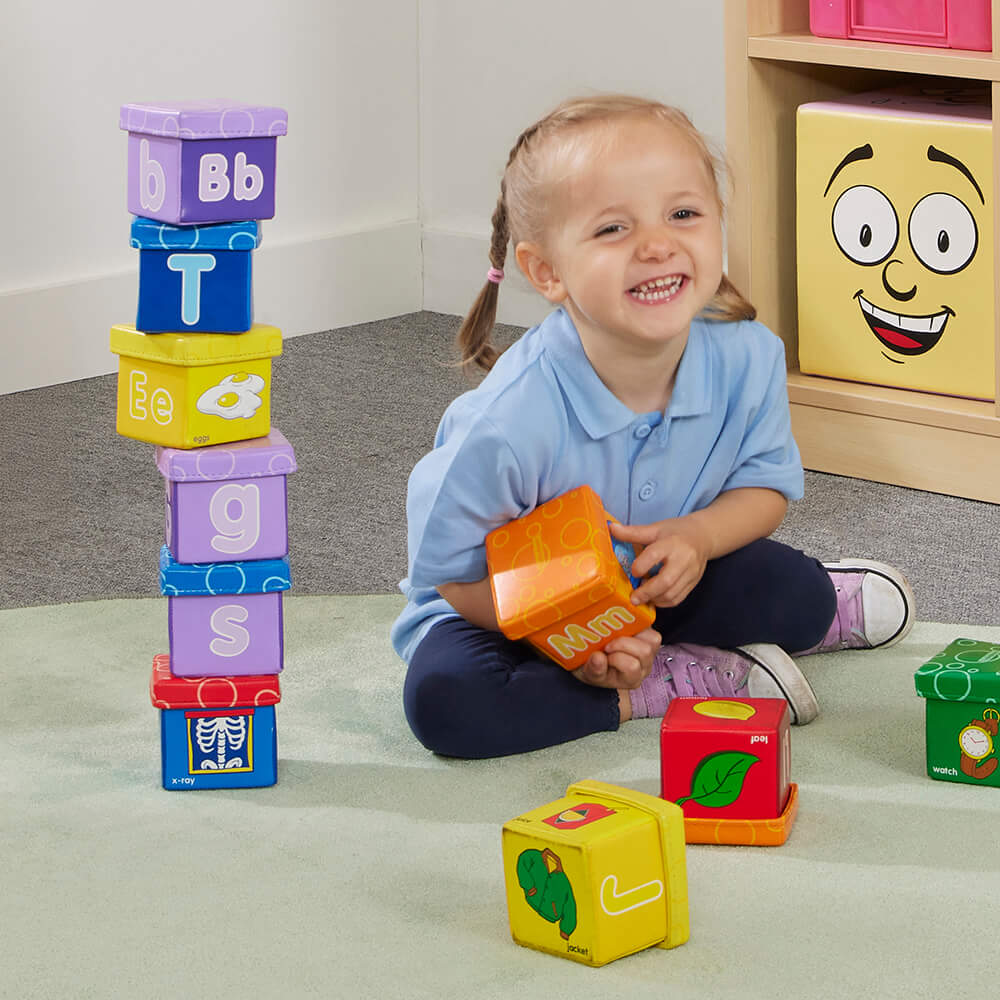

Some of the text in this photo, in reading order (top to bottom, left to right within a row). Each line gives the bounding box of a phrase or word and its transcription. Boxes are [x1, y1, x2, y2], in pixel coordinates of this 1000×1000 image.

[139, 138, 165, 212] b
[199, 151, 264, 202] Bb
[167, 254, 216, 325] T
[129, 370, 174, 426] Ee
[193, 434, 210, 444] eggs
[209, 484, 260, 554] g
[547, 606, 635, 659] Mm
[750, 736, 768, 744] leaf
[171, 776, 196, 786] x-ray
[932, 765, 958, 776] watch
[566, 942, 588, 956] jacket
